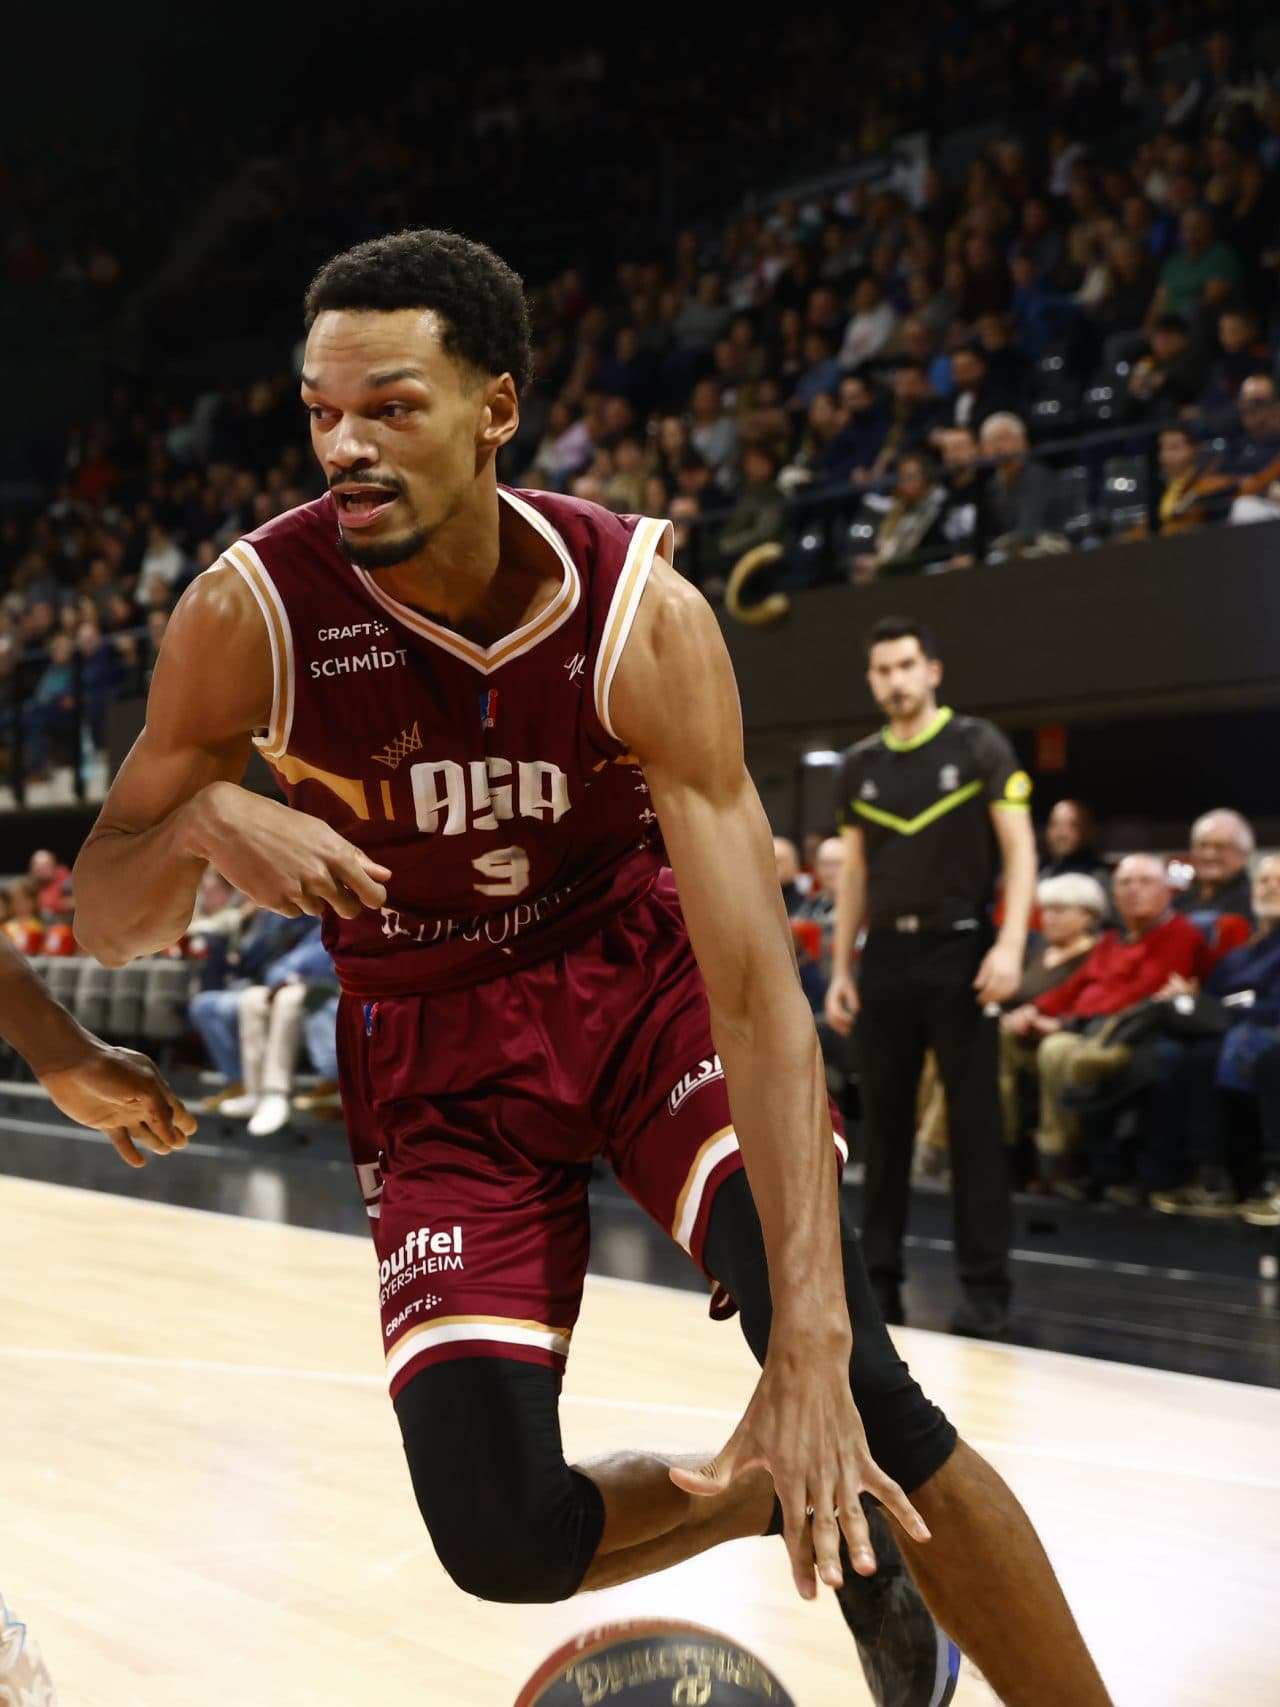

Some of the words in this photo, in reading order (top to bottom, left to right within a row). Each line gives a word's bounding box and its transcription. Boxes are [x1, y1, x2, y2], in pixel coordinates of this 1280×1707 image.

[318, 622, 372, 641] CRAFT
[410, 756, 572, 836] ASA
[472, 845, 530, 896] 9
[379, 1226, 462, 1286] ouffel
[380, 1255, 464, 1306] EYERSHEIM
[385, 1299, 424, 1337] CRAFT
